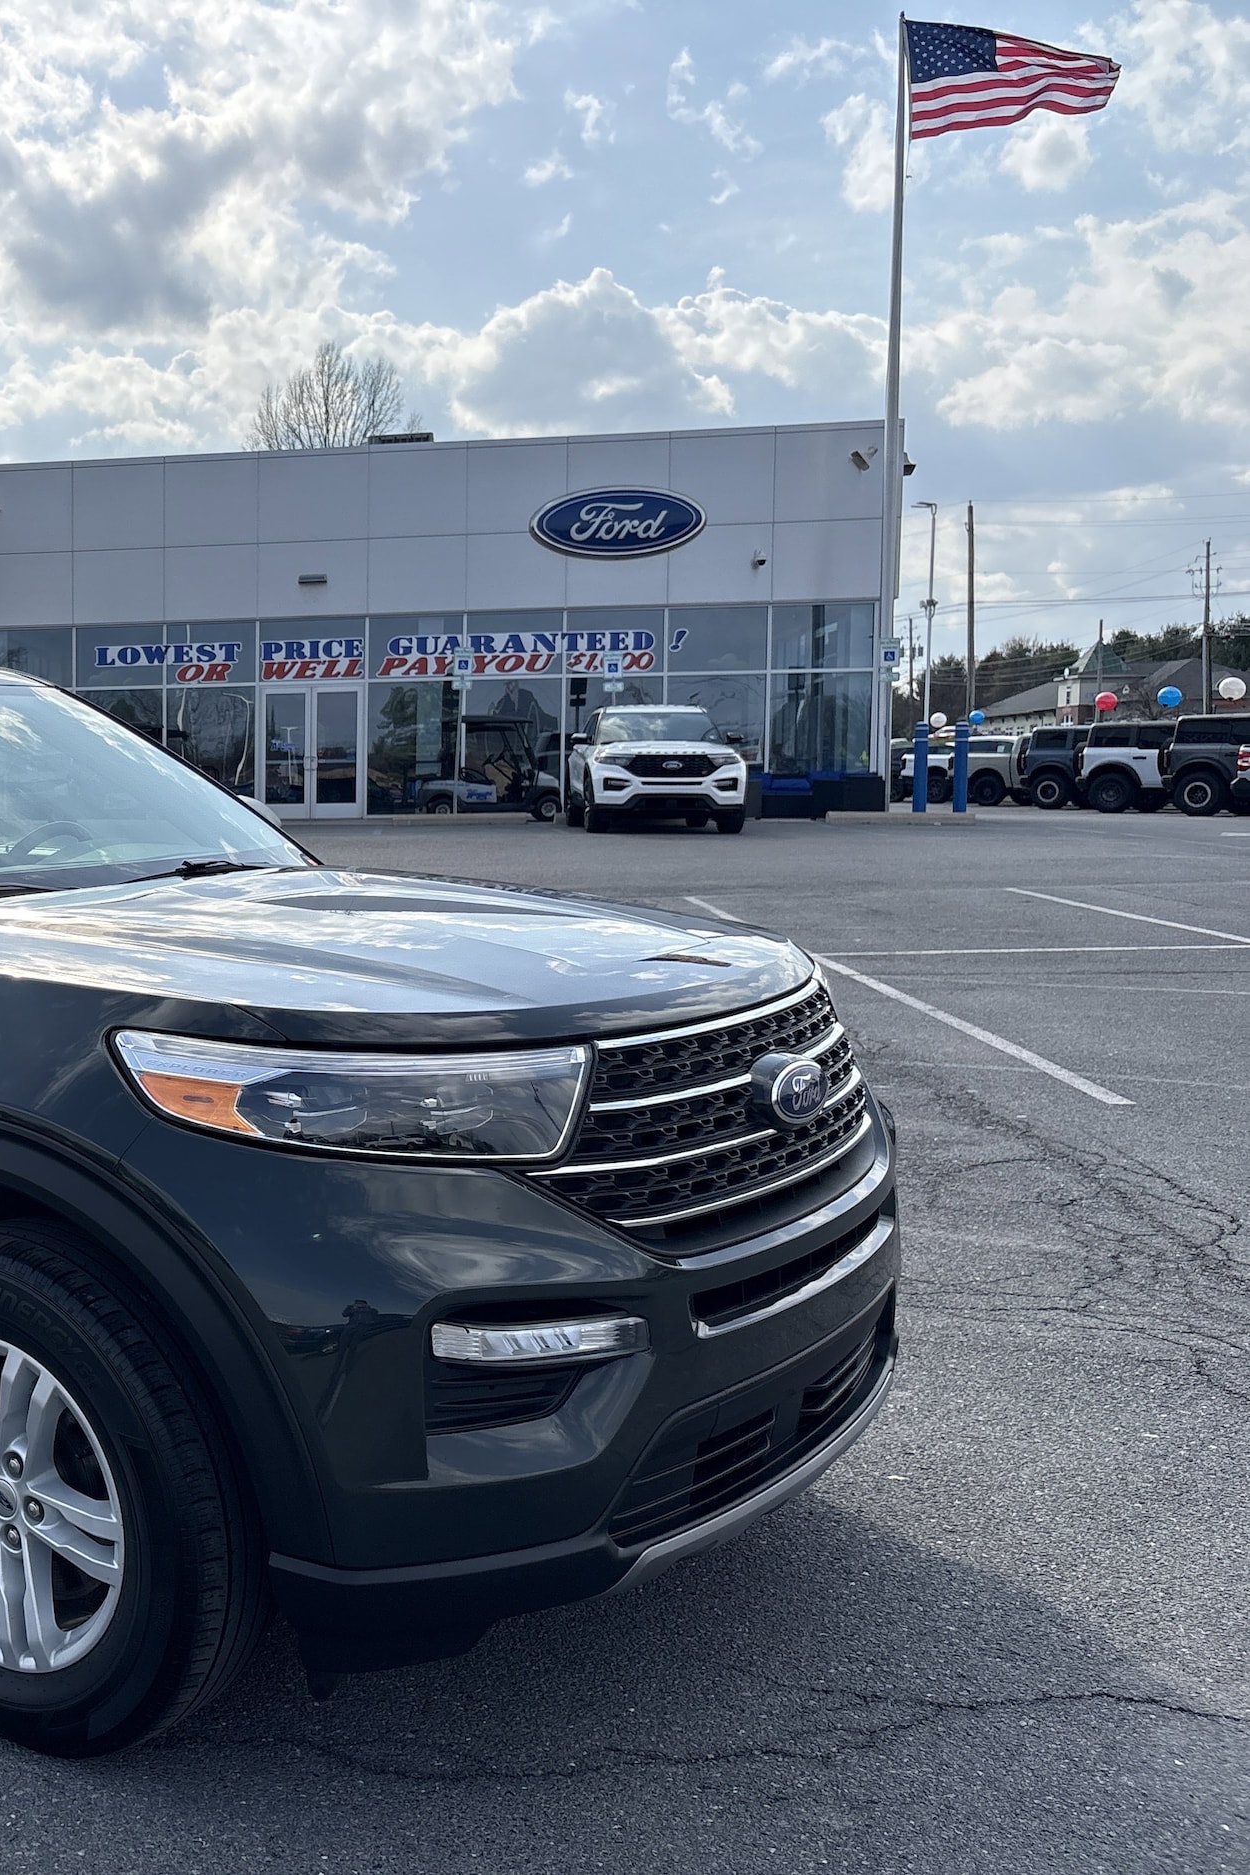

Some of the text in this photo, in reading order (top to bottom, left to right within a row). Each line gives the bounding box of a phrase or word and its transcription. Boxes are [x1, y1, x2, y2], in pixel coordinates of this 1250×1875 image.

[570, 503, 668, 541] Ford
[96, 644, 241, 666] LOWEST
[262, 639, 363, 660] PRICE
[388, 631, 655, 656] GUARANTEED
[671, 630, 687, 650] !
[177, 664, 231, 682] OR
[263, 659, 362, 680] WE'LL
[377, 655, 453, 675] PAY
[471, 653, 552, 674] YOU
[568, 652, 654, 672] $1,00
[146, 1060, 248, 1079] EXPLORER
[792, 1073, 822, 1111] Ford
